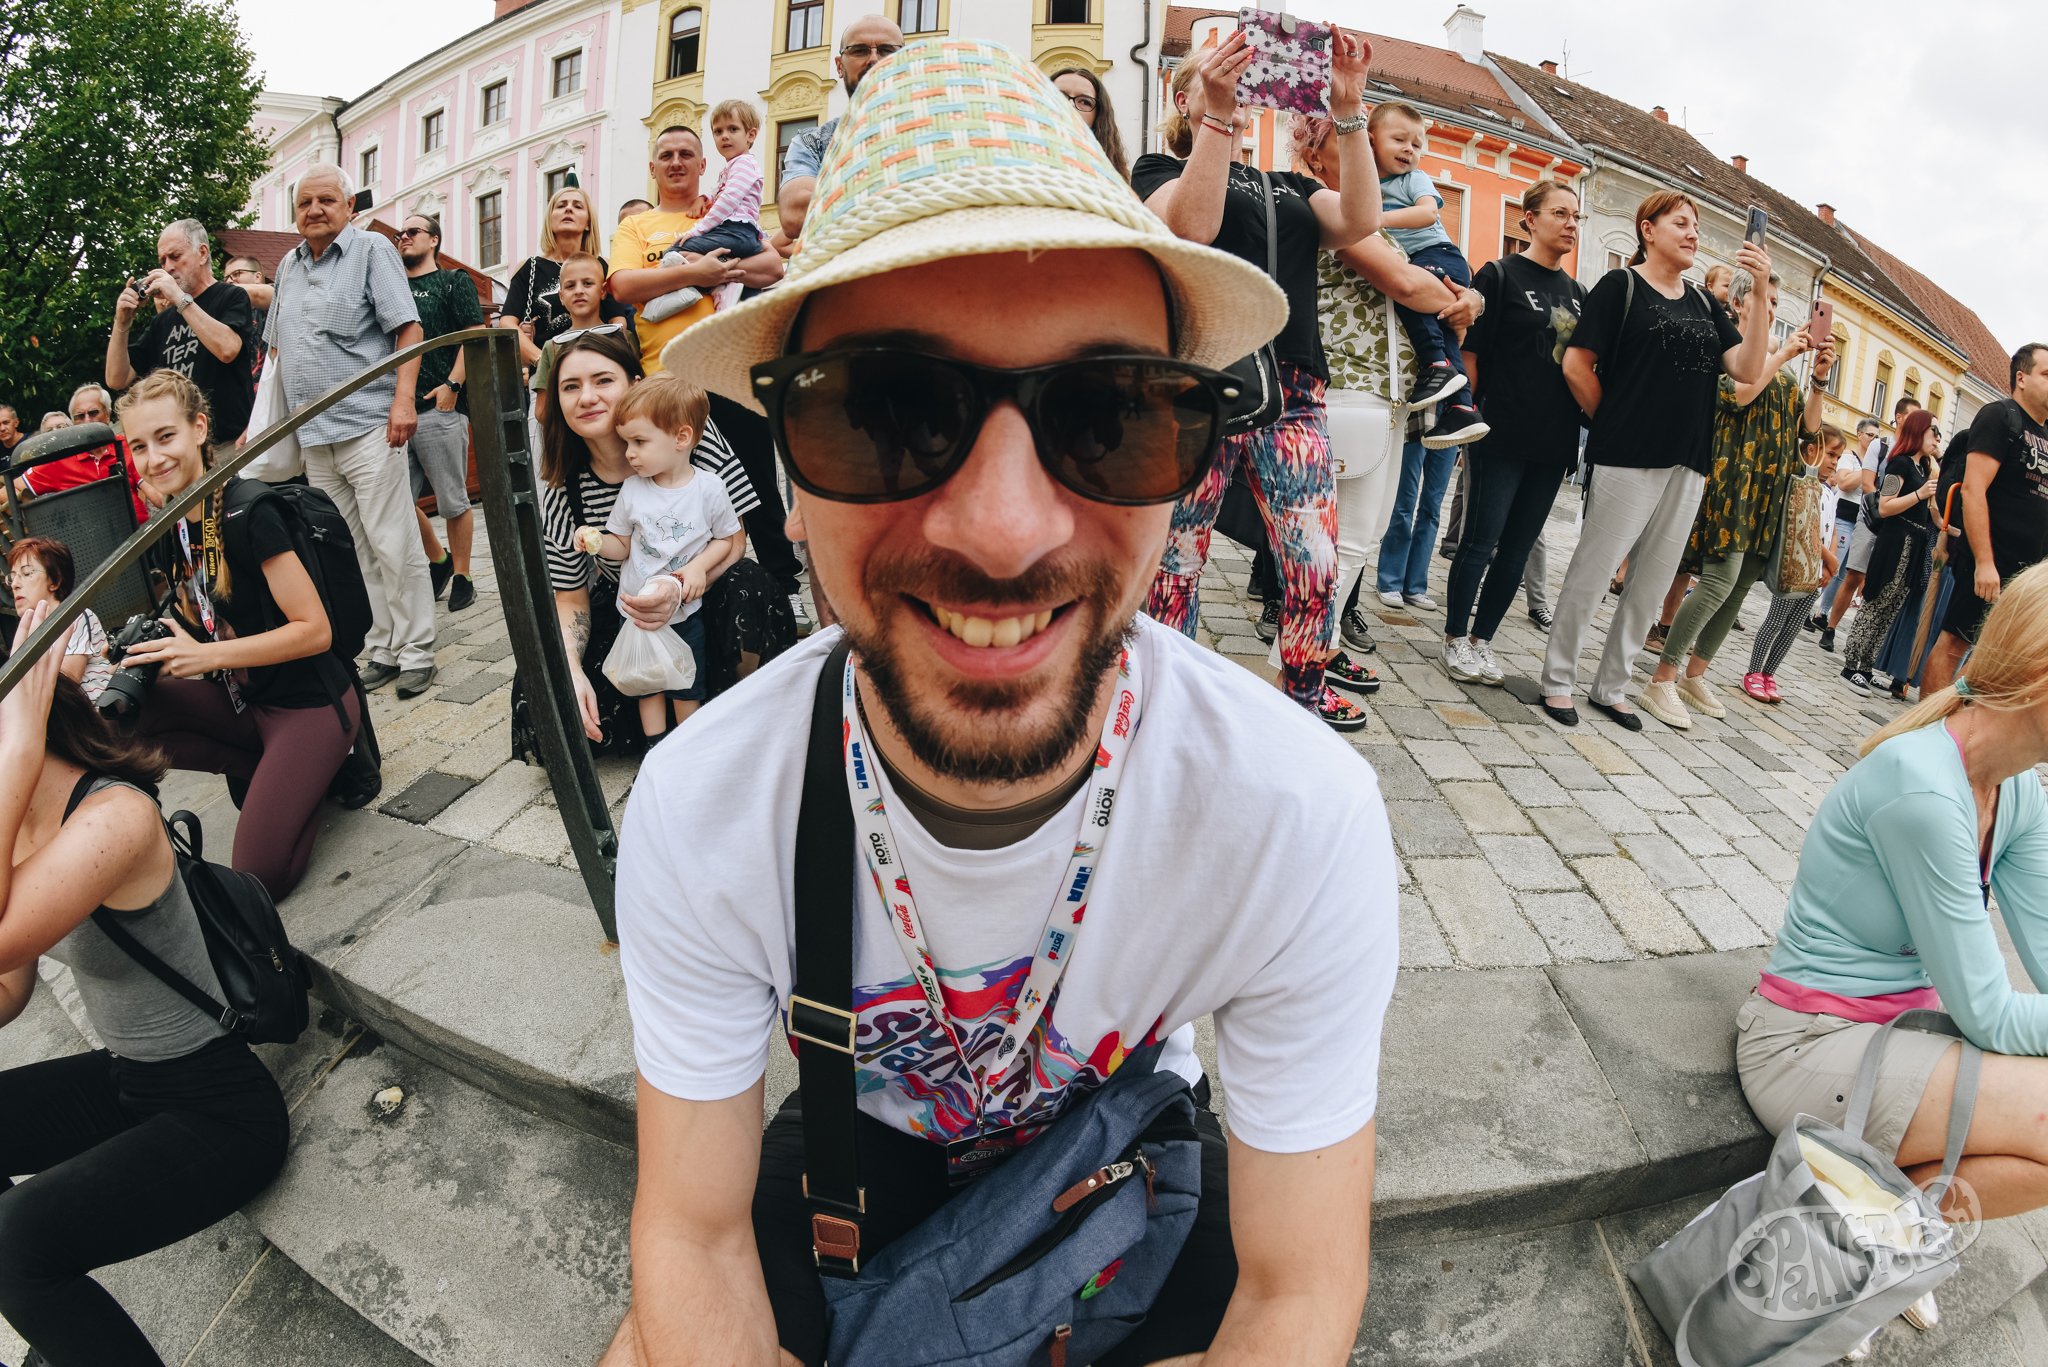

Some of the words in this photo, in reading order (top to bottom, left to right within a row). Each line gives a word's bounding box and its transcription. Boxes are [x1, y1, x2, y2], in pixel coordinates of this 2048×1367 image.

[163, 340, 199, 365] TER
[1097, 789, 1114, 827] ROTO
[870, 833, 888, 864] ROTO
[1051, 933, 1064, 952] ERSTE
[919, 974, 938, 1004] PAN
